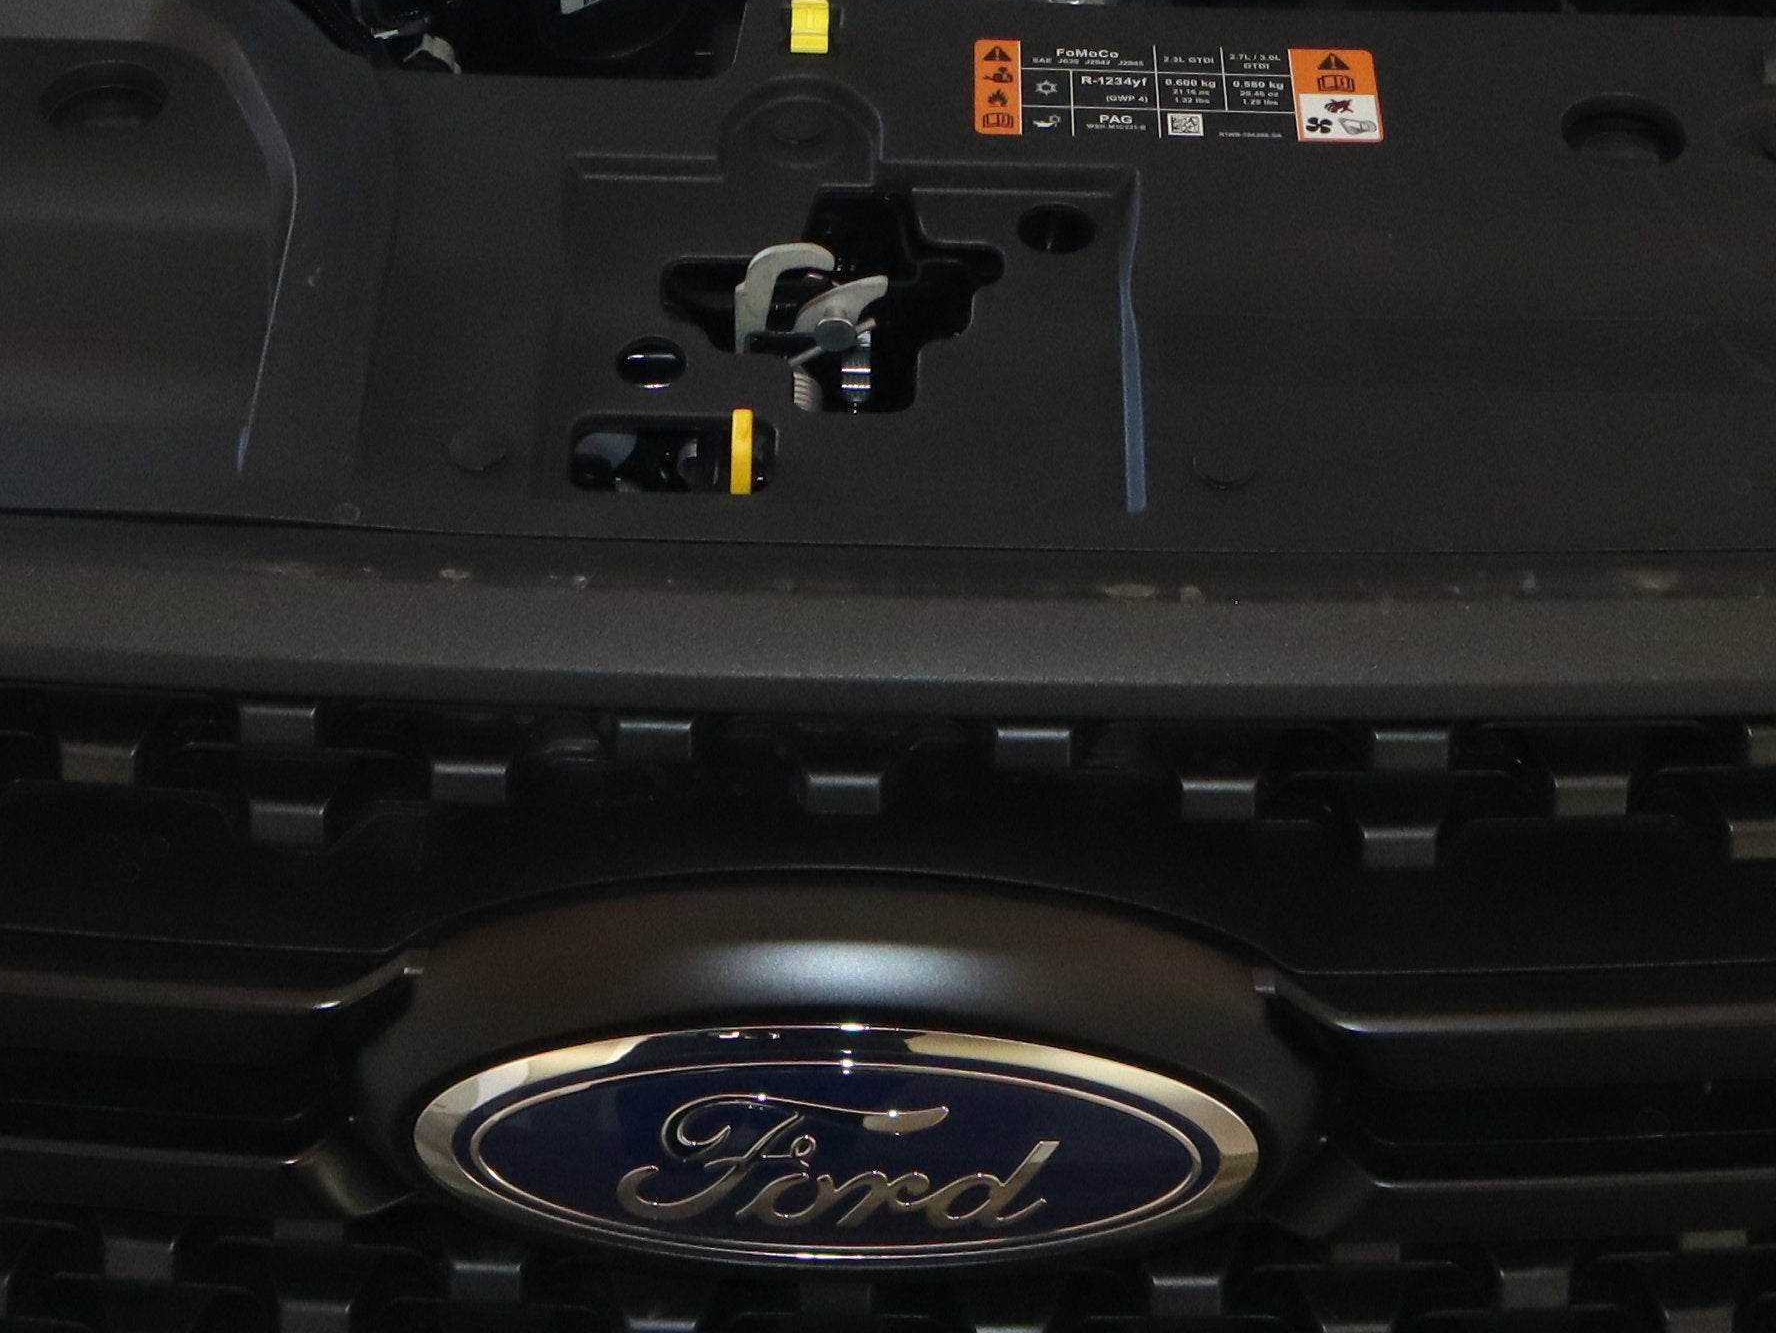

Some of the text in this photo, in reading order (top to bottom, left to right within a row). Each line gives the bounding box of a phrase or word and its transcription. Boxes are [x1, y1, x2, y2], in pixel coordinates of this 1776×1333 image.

[1056, 48, 1119, 59] FoMoCo
[1080, 76, 1149, 88] R-1234yf
[1200, 79, 1217, 89] kg
[1268, 81, 1285, 91] kg
[1099, 114, 1134, 124] PAG
[617, 1092, 1061, 1229] Ford
